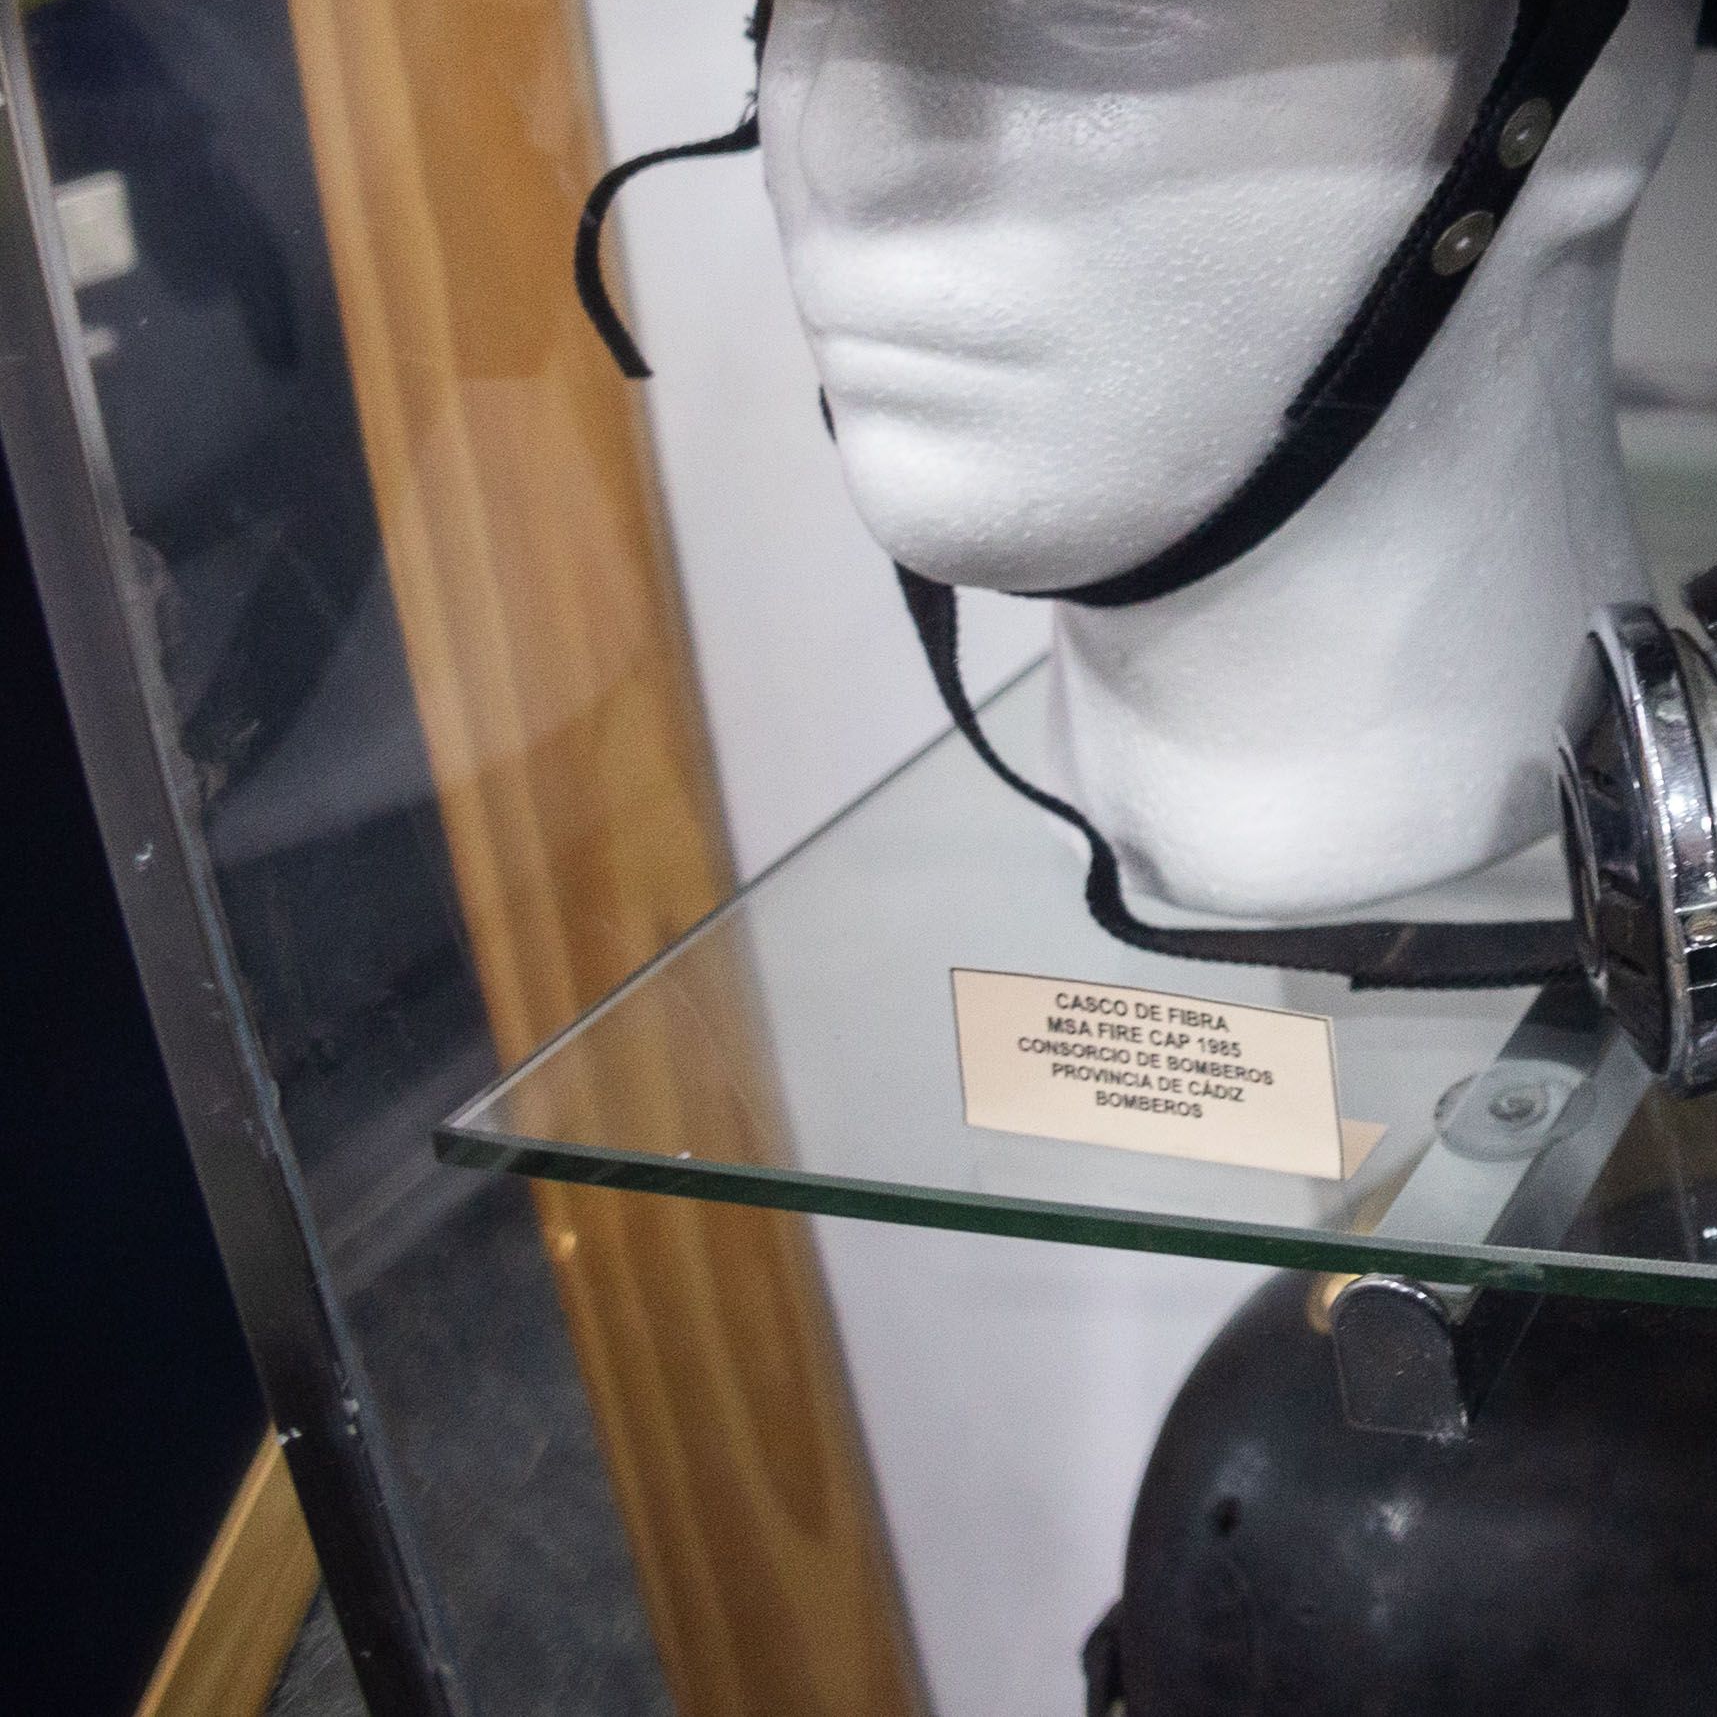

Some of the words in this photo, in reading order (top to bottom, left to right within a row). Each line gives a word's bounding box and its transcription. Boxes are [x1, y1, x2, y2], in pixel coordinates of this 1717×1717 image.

[1054, 993, 1129, 1016] CASCO
[1132, 1003, 1163, 1021] DE
[1166, 1007, 1231, 1030] FIBRA
[1045, 1017, 1094, 1035] MSA
[1095, 1023, 1143, 1043] FIRE
[1148, 1030, 1191, 1048] CAP
[1196, 1038, 1243, 1058] 1985
[1016, 1038, 1132, 1063] CONSORCIO
[1134, 1051, 1162, 1068] DE
[1165, 1056, 1276, 1085] BOMBEROS
[1050, 1063, 1154, 1087] PROVINCIA
[1156, 1076, 1183, 1093] DE
[1187, 1080, 1245, 1102] CÁDIZ
[1094, 1091, 1204, 1118] BOMBEROS
